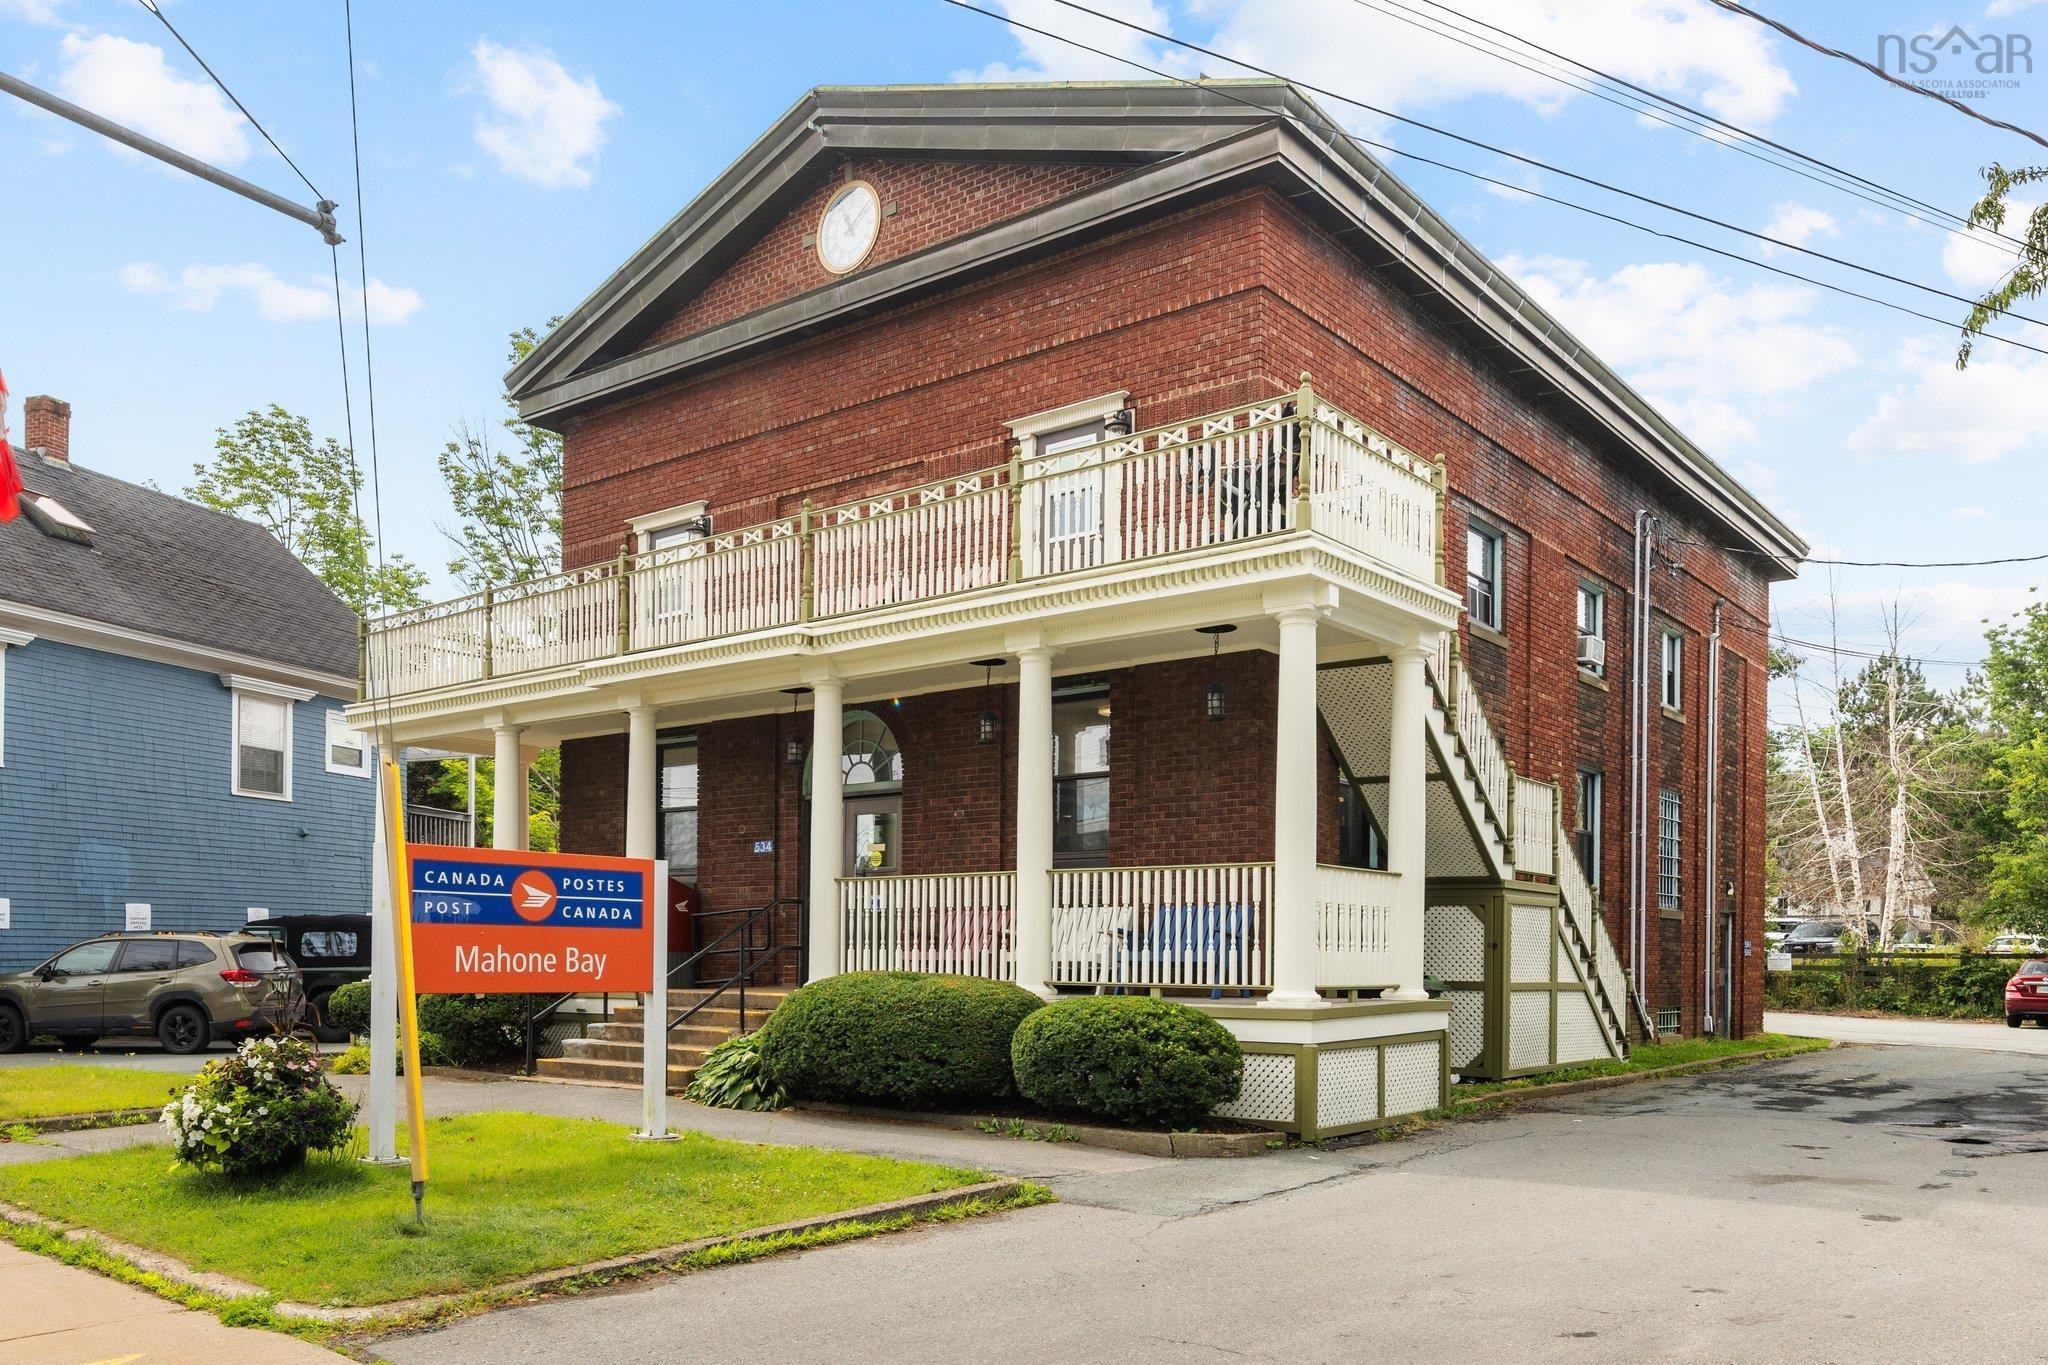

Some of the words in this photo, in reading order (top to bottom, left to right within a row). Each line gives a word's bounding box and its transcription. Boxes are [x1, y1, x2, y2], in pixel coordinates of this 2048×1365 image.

[754, 841, 772, 853] 534
[424, 870, 505, 887] CANADA
[562, 877, 625, 892] POSTES
[424, 901, 472, 915] POST
[562, 906, 633, 920] CANADA
[455, 944, 556, 973] Mahone
[565, 947, 607, 980] Bay
